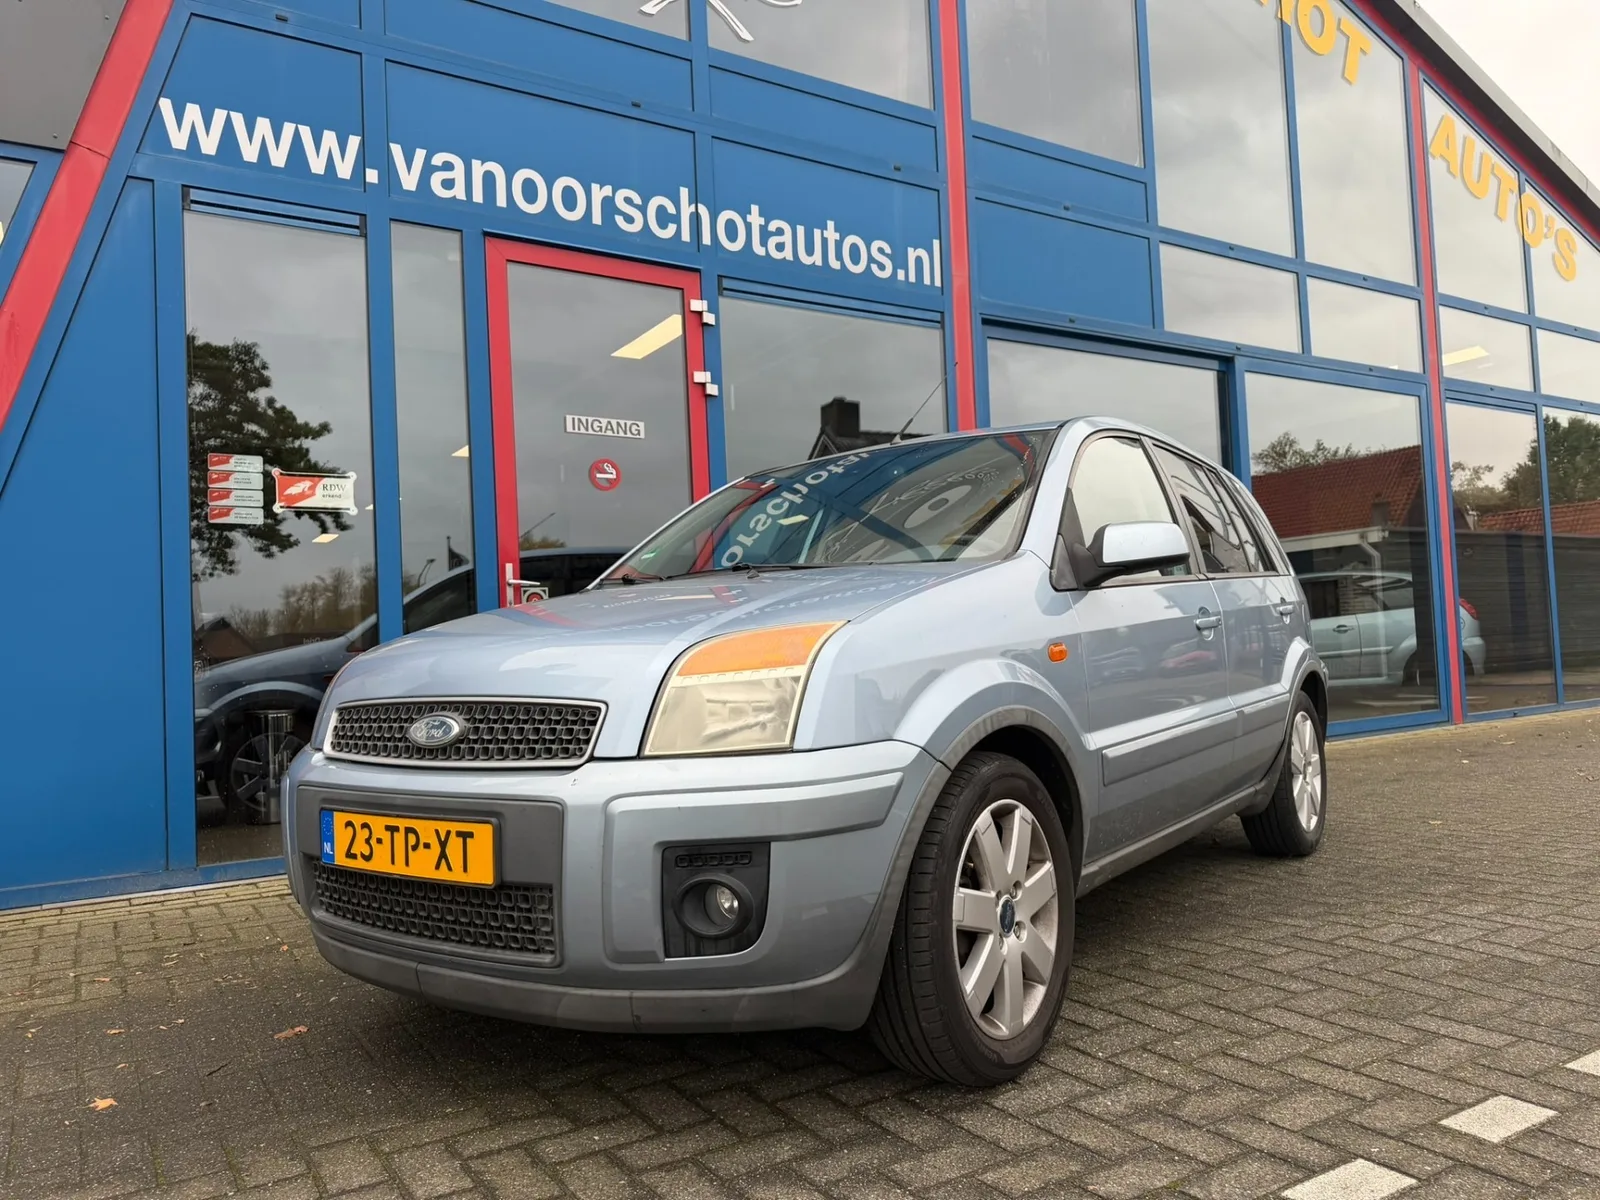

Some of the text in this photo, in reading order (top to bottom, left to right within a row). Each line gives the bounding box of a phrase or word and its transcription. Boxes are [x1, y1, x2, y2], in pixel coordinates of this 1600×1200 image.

[1255, 0, 1372, 85] OT
[158, 97, 942, 288] www.vanoorschotautos.nl
[1430, 112, 1577, 282] AUTO'S
[571, 416, 642, 437] INGANG
[322, 484, 346, 492] RDW
[416, 719, 448, 738] Ford
[323, 842, 334, 855] NL
[344, 820, 475, 873] 23-TP-XT
